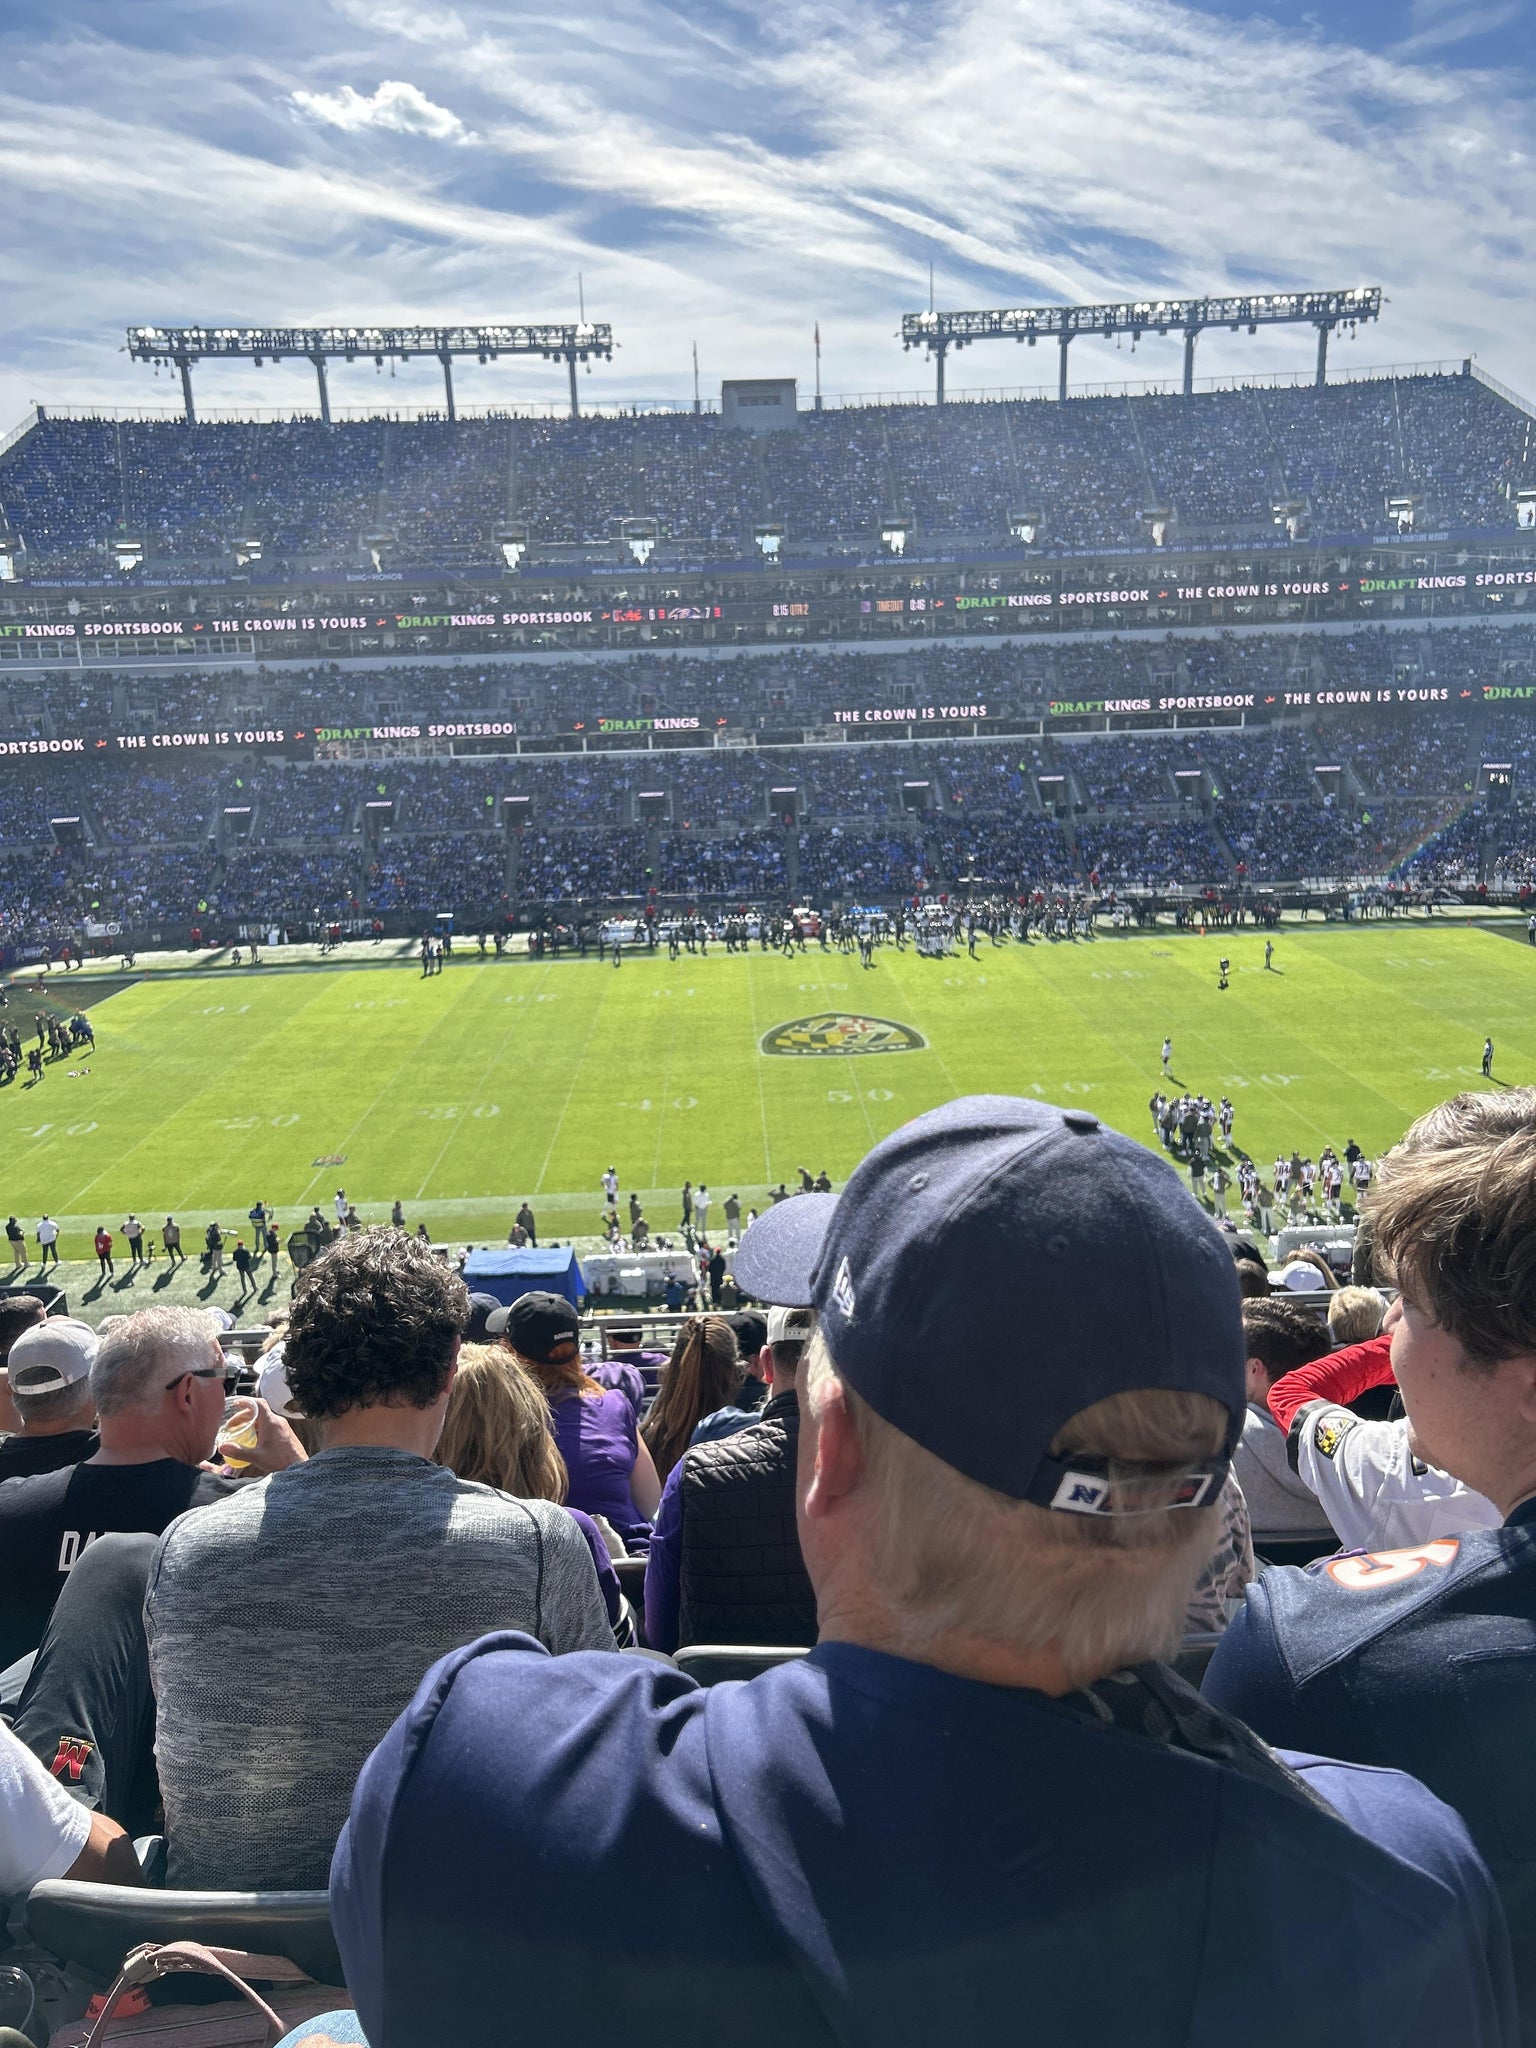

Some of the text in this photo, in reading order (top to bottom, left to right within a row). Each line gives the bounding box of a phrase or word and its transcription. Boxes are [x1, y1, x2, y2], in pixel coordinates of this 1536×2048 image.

[1176, 581, 1330, 600] THE CROWN IS YOURS
[1360, 576, 1467, 593] DRAFTKINGS
[956, 589, 1150, 610] DRAFTKINGS SPORTSBOOK
[84, 621, 184, 636] SPORTSBOOK
[212, 616, 368, 632] THE CROWN IS YOURS
[396, 610, 593, 629] DRAFTKINGS SPORTSBOOK
[1051, 694, 1255, 715] DRAFTKINGS SPORTSBOOK
[1284, 687, 1449, 705] THE CROWN IS YOURS
[833, 704, 987, 723] THE CROWN IS YOURS
[316, 725, 421, 742] DRAFTKINGS
[600, 717, 700, 733] DRAFTKINGS
[117, 730, 285, 749] THE CROWN IS YOURS
